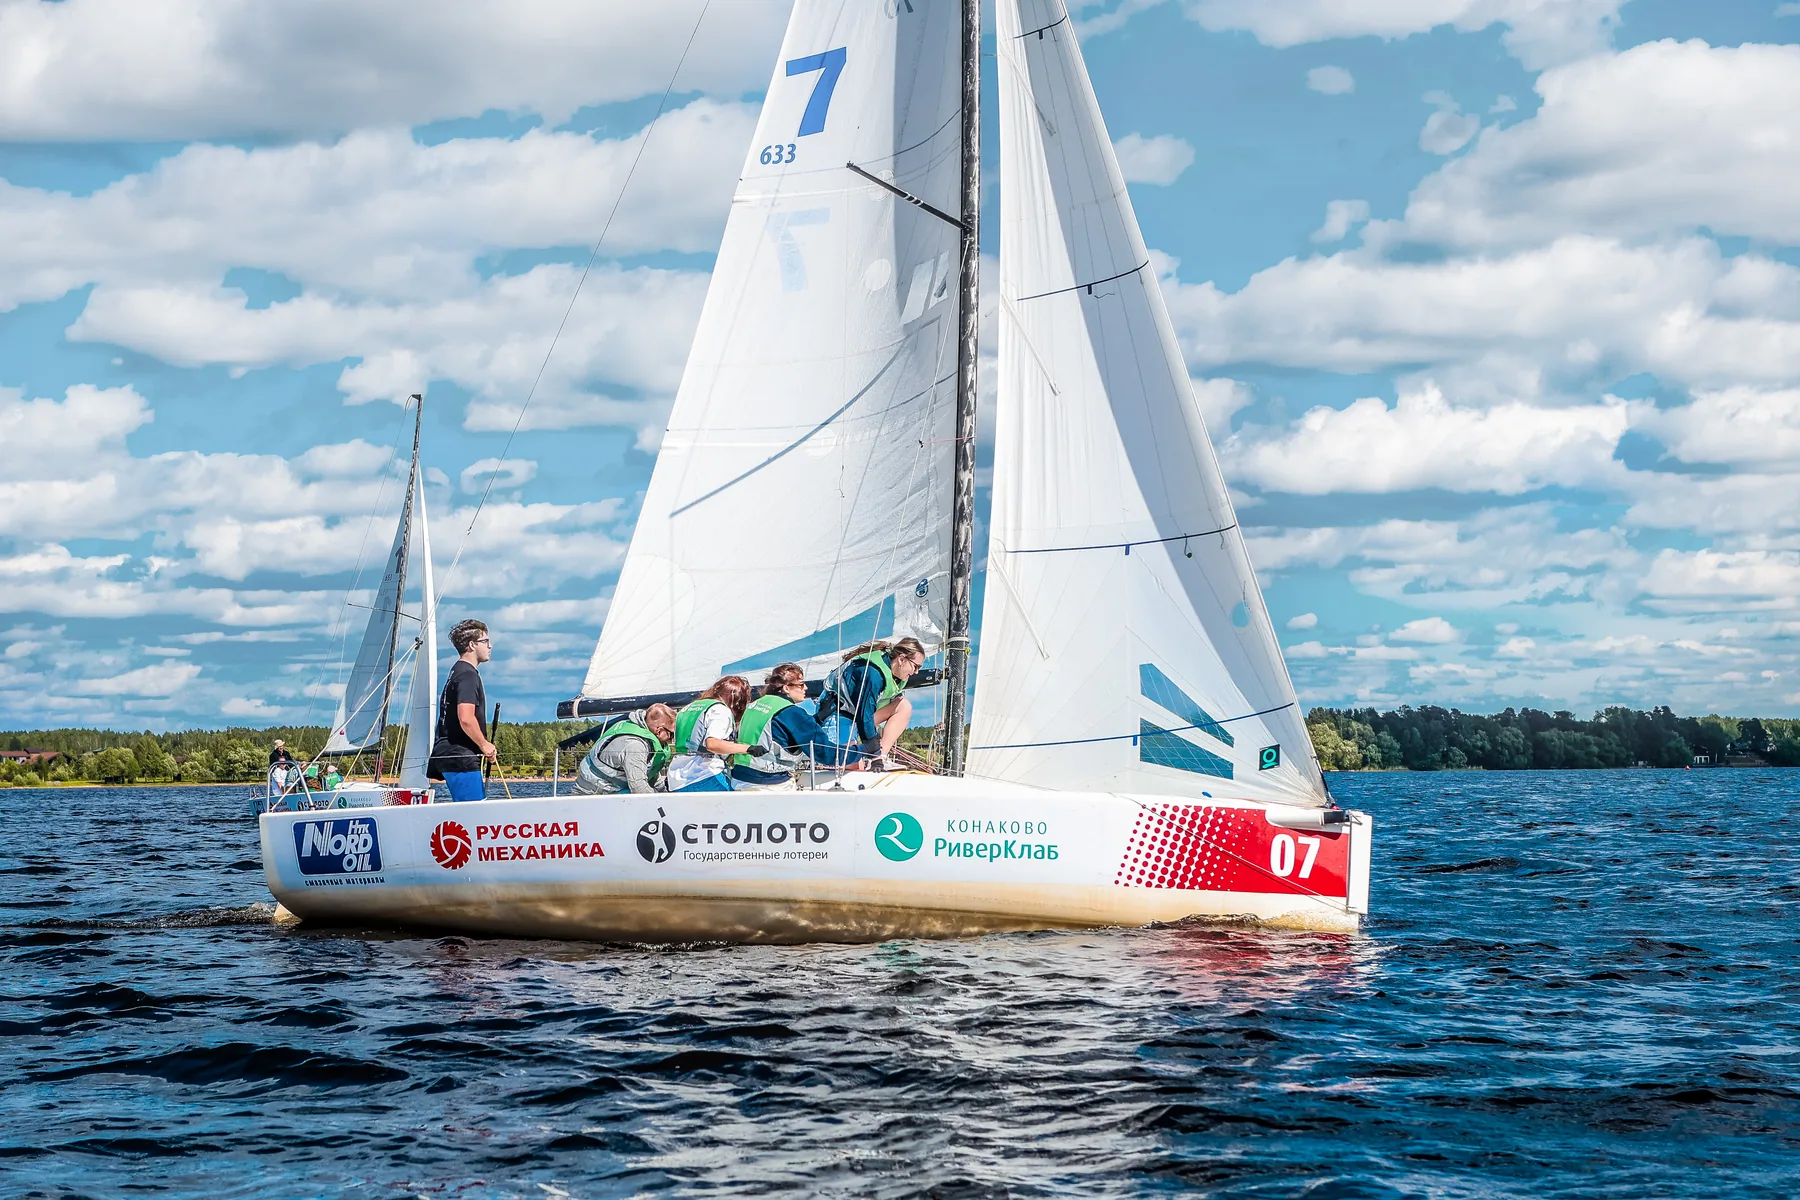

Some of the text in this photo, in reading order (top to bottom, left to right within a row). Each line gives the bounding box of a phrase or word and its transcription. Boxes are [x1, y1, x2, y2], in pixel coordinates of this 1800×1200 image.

[785, 46, 847, 137] 7
[759, 143, 797, 165] 633
[476, 821, 579, 841] РУССКАЯ
[947, 819, 1048, 835] КОНАКОВО
[478, 841, 605, 862] МЕХАНИКА
[683, 850, 828, 862] Государственные лотереи
[934, 839, 1059, 862] РиверКлаб
[1270, 833, 1320, 879] 07
[342, 853, 372, 872] OIL
